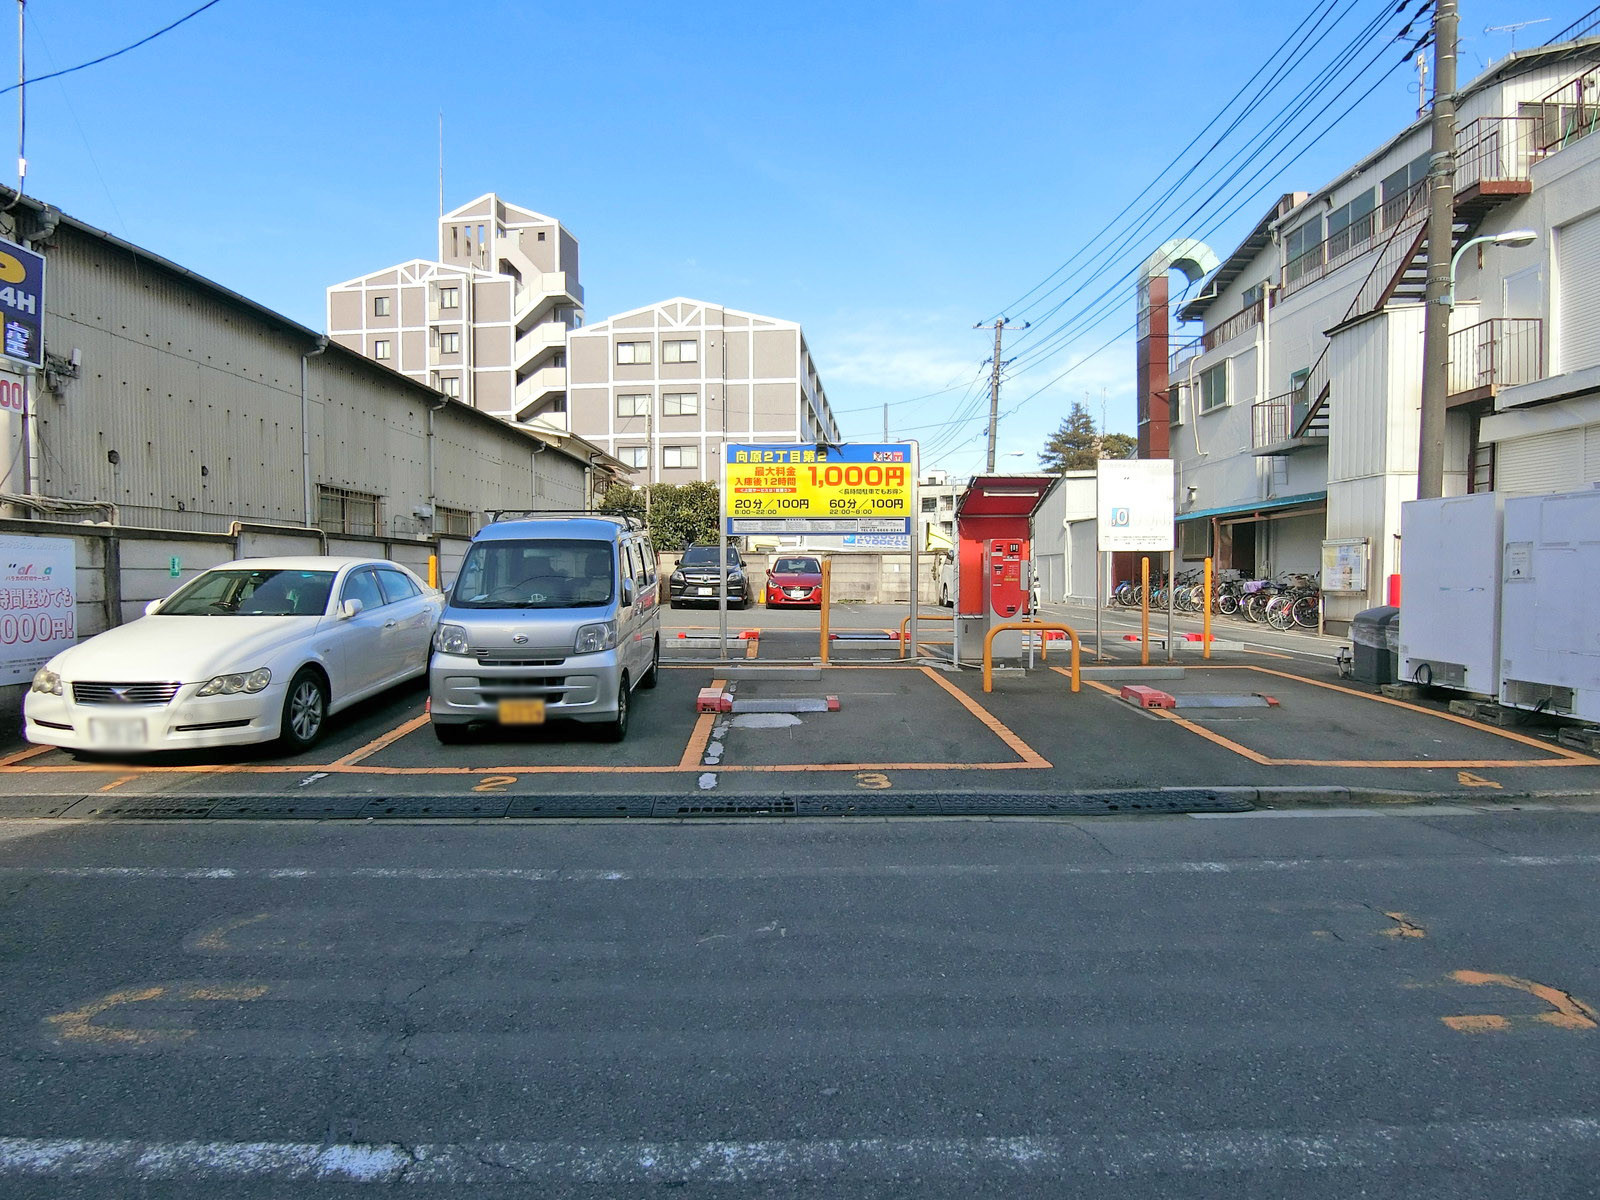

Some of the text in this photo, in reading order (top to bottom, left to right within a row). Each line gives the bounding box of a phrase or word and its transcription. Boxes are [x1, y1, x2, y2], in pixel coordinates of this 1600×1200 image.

[736, 450, 826, 462] 向原2丁目第2
[755, 466, 796, 476] 最大料金
[808, 466, 904, 488] 1,000円
[735, 477, 796, 486] 入庫後12時間
[853, 773, 892, 789] 3
